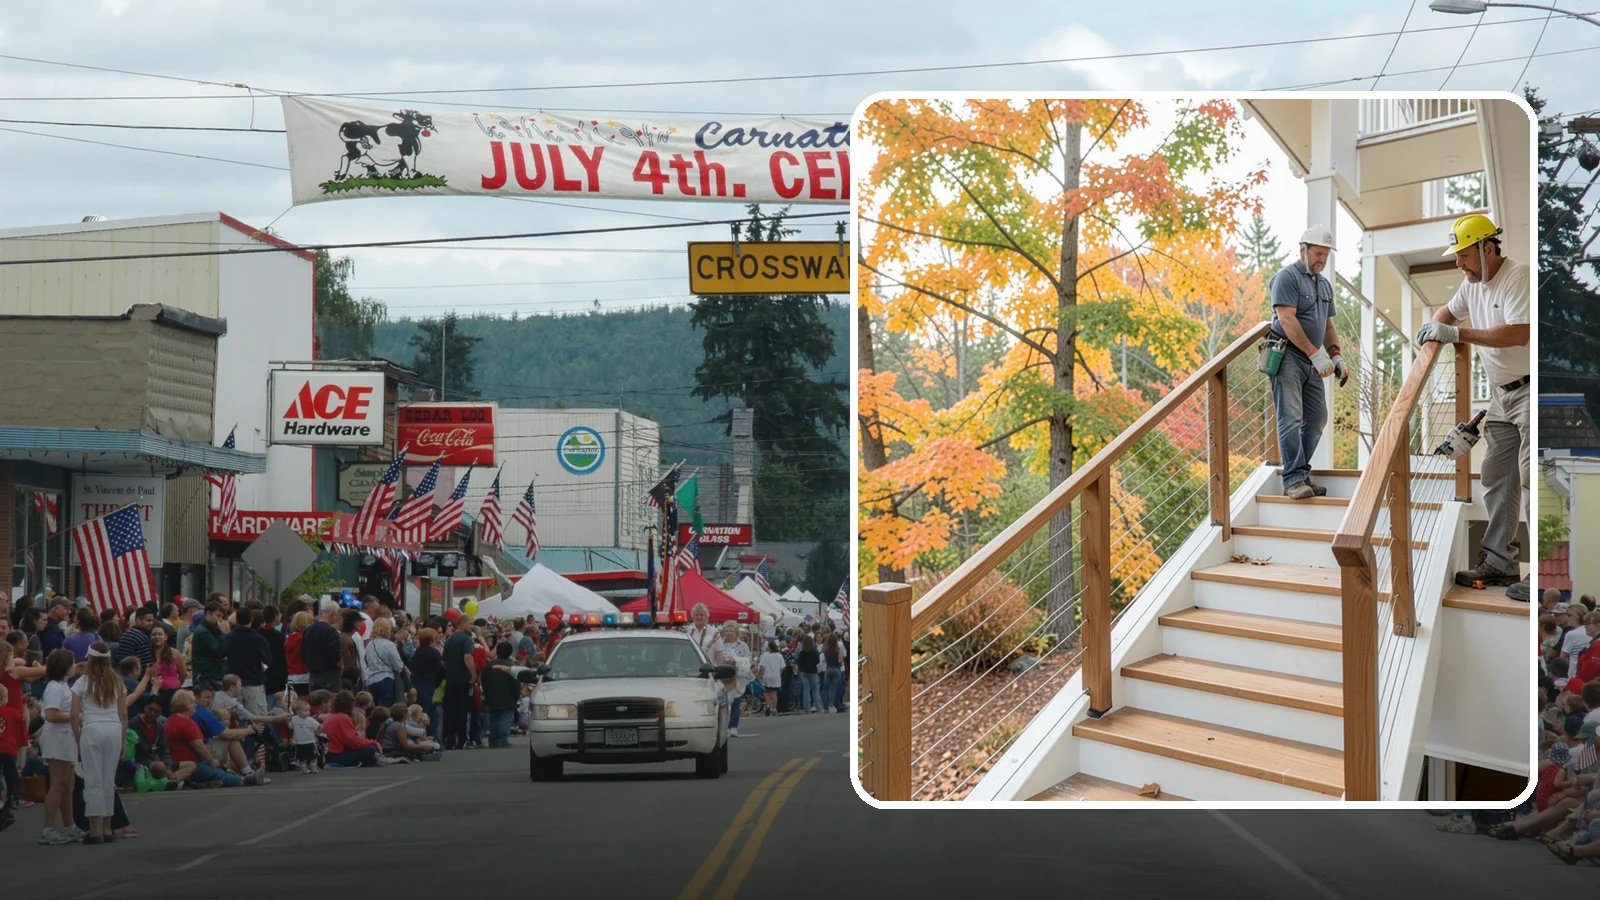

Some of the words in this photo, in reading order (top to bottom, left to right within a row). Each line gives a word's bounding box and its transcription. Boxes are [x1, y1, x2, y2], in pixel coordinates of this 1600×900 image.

[481, 141, 605, 192] JULY
[632, 150, 746, 198] 4th.
[697, 254, 850, 280] CROSSWA
[283, 380, 373, 420] ACE
[406, 409, 452, 422] CEDAR
[283, 421, 371, 436] Hardware
[83, 485, 93, 494] St.
[95, 485, 124, 495] Vincent
[126, 485, 135, 495] de
[137, 486, 155, 495] Paul
[688, 526, 741, 535] CRNATION
[699, 535, 730, 543] GLASS
